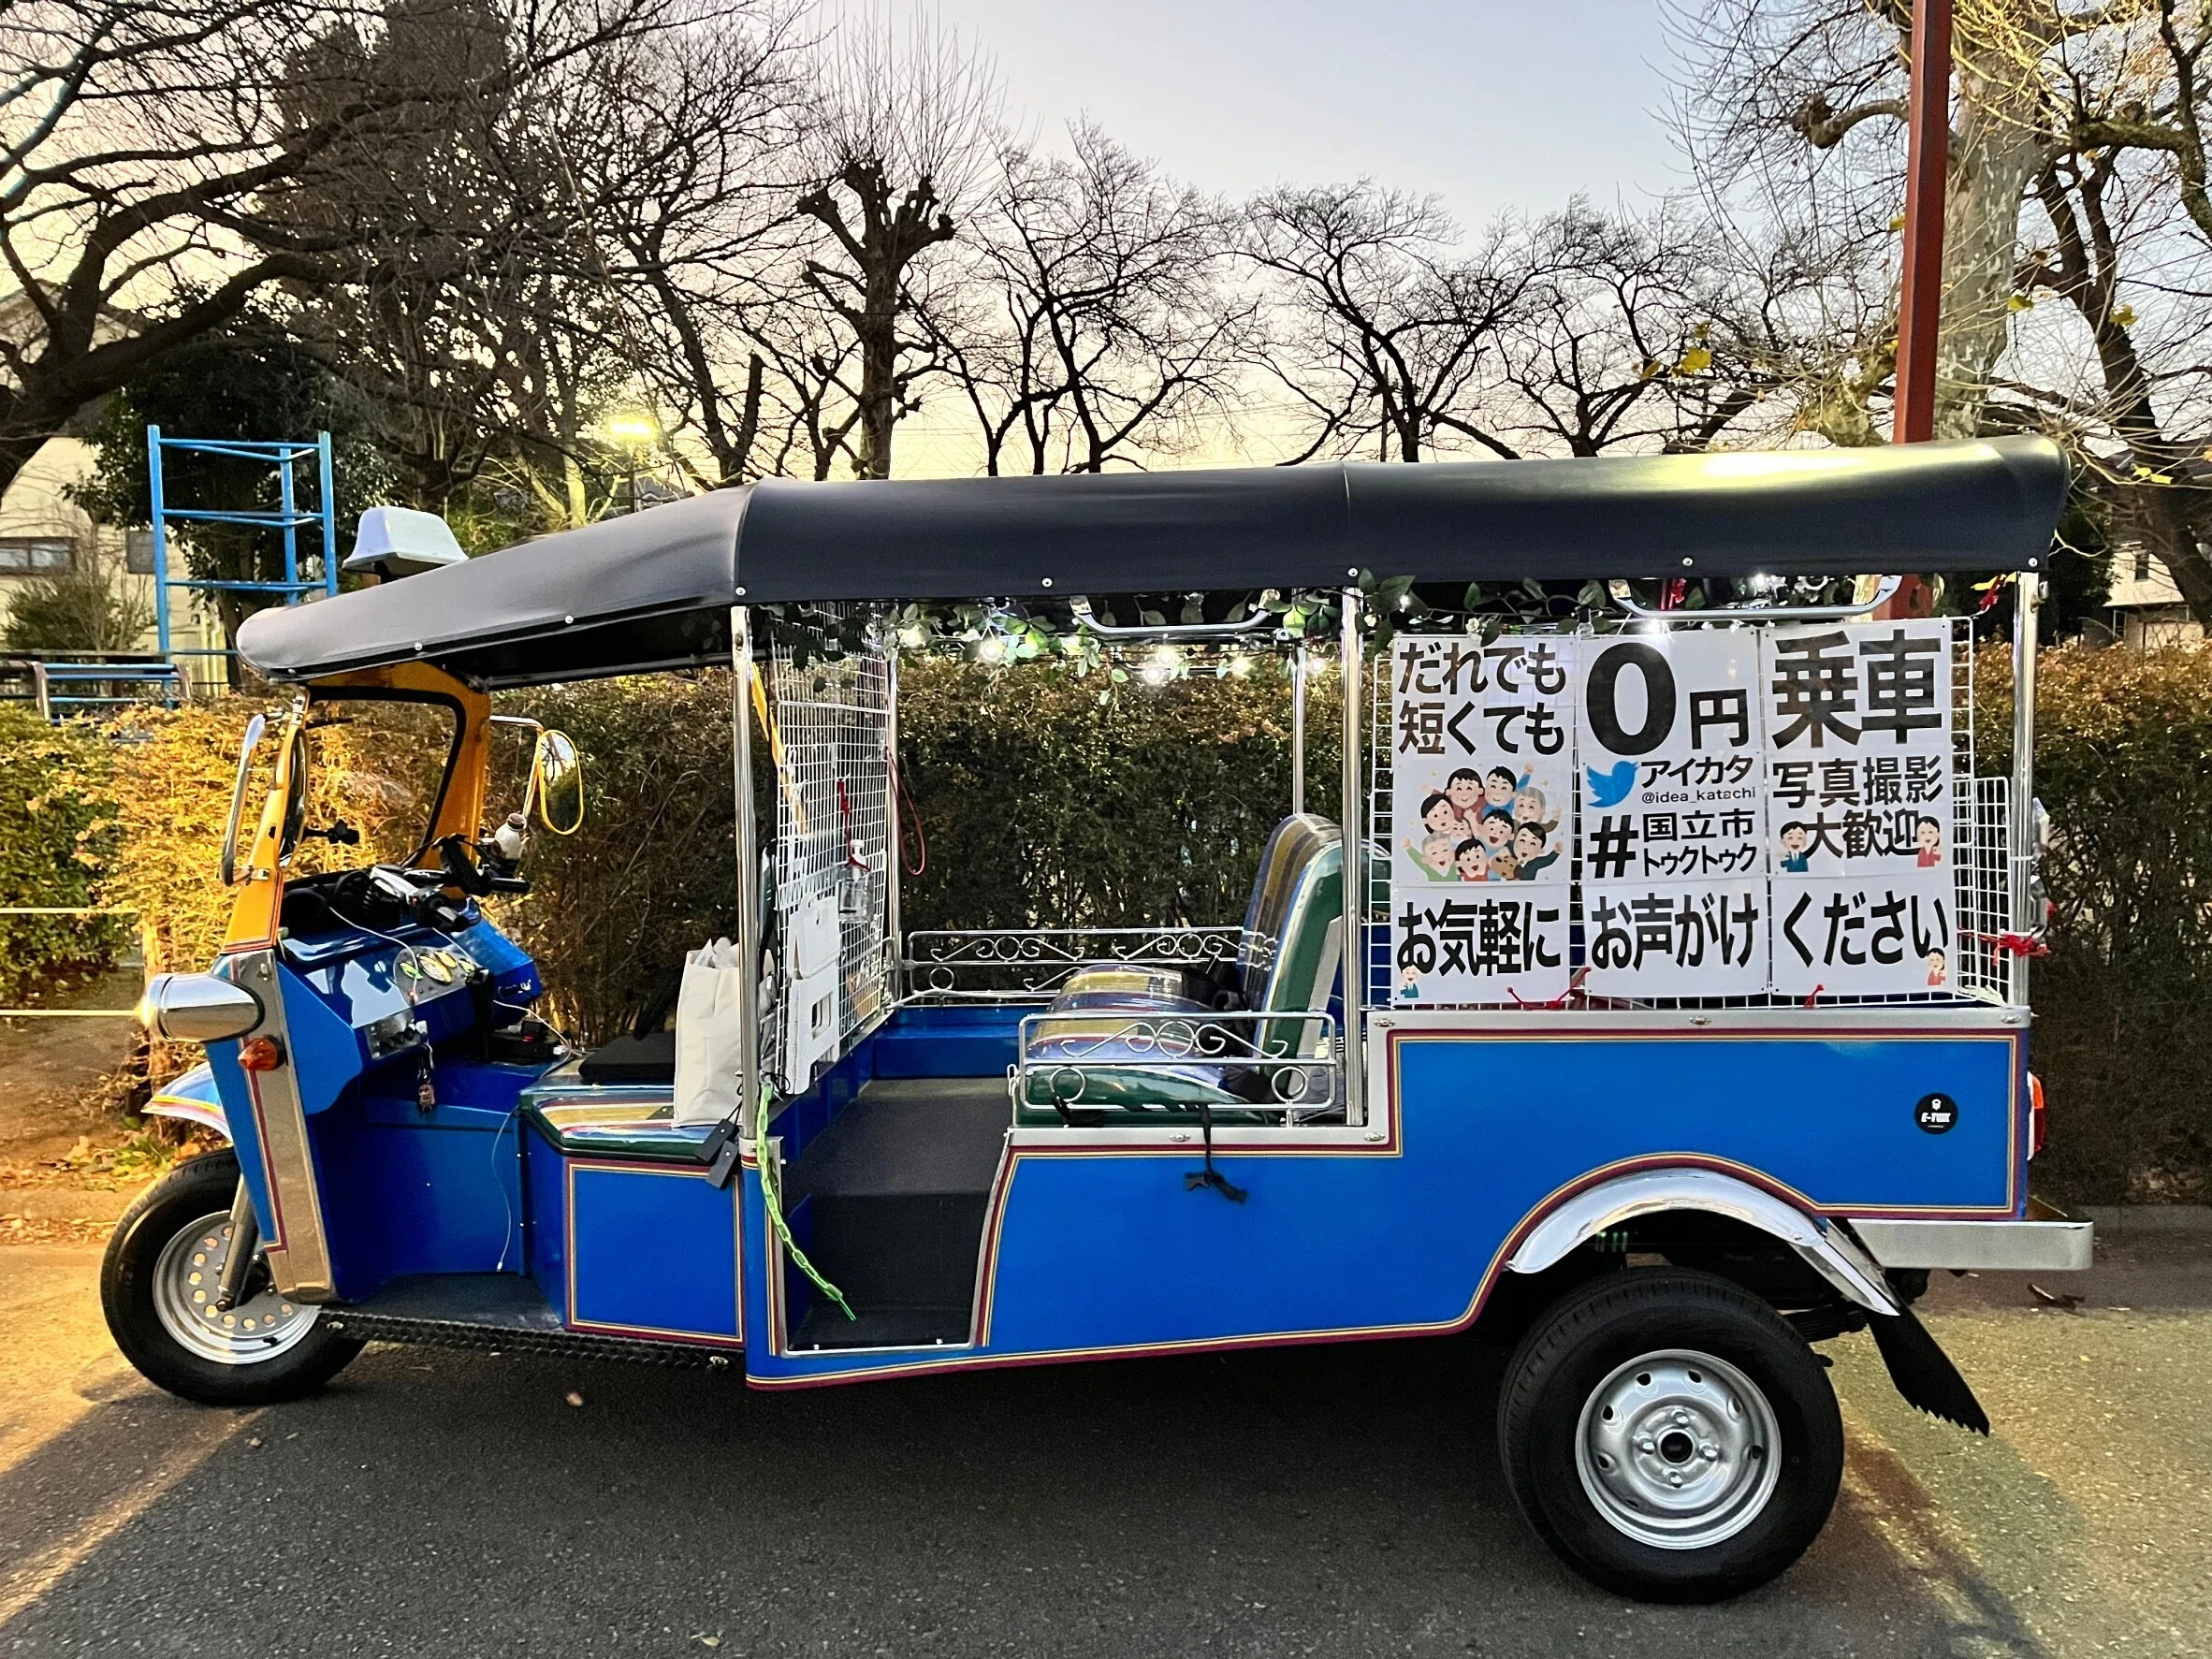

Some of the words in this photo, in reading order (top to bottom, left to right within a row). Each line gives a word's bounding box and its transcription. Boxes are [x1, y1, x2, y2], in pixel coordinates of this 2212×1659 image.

[1398, 642, 1566, 694] だれでも
[1772, 628, 1944, 749] 乗車
[1398, 701, 1565, 755] 短くても
[1641, 755, 1754, 789] アイカタ
[1642, 787, 1756, 804] @idea_katachi
[1772, 754, 1944, 805] 写真撮影
[1642, 808, 1755, 842] 国立市
[1806, 808, 1921, 859] 大歓迎
[1643, 843, 1757, 877] トゥクトゥク
[1397, 898, 1562, 977] お気軽に
[1591, 893, 1759, 971] お声がけ
[1783, 890, 1949, 970] ください
